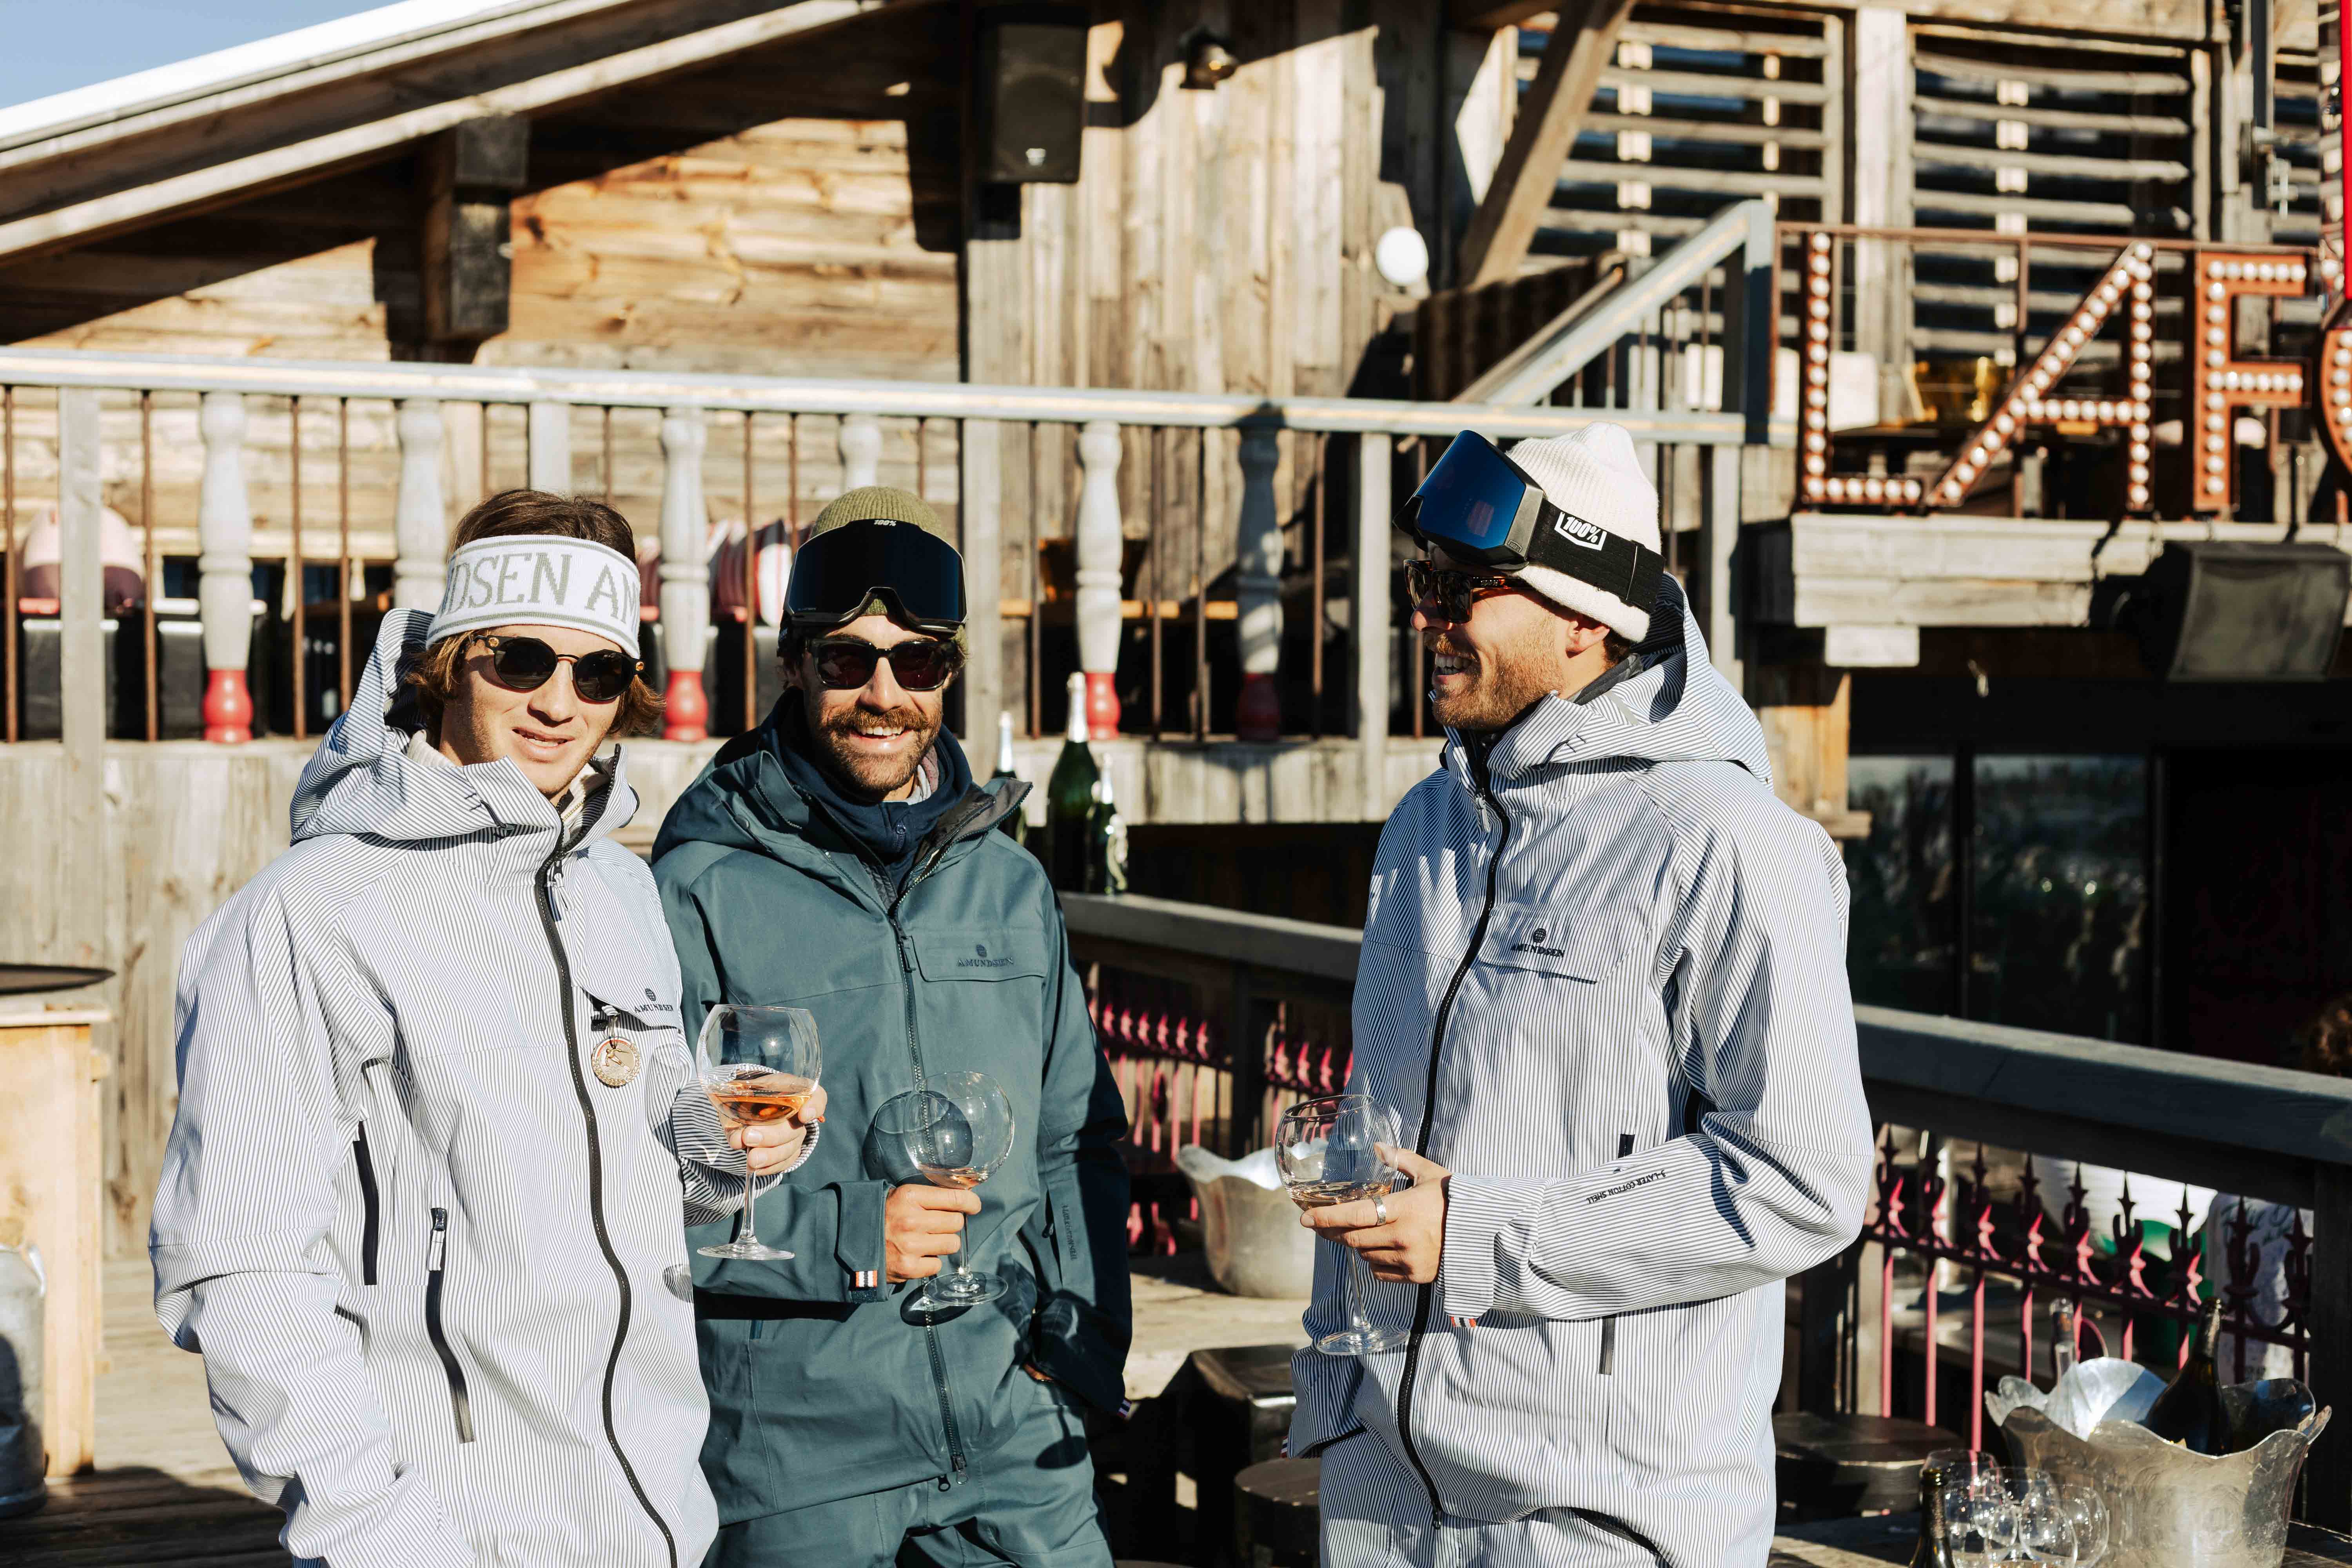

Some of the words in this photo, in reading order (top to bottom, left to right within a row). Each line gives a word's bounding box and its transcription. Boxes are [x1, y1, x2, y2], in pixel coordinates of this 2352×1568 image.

[1805, 231, 2154, 510] LA
[1563, 517, 1601, 543] 100%
[1511, 943, 1565, 958] AMUNDSEN
[956, 957, 1014, 967] AMUNDSEN
[1637, 1169, 1666, 1186] 3-LAYER
[1608, 1181, 1636, 1196] COTTON
[1586, 1191, 1607, 1204] SHELL
